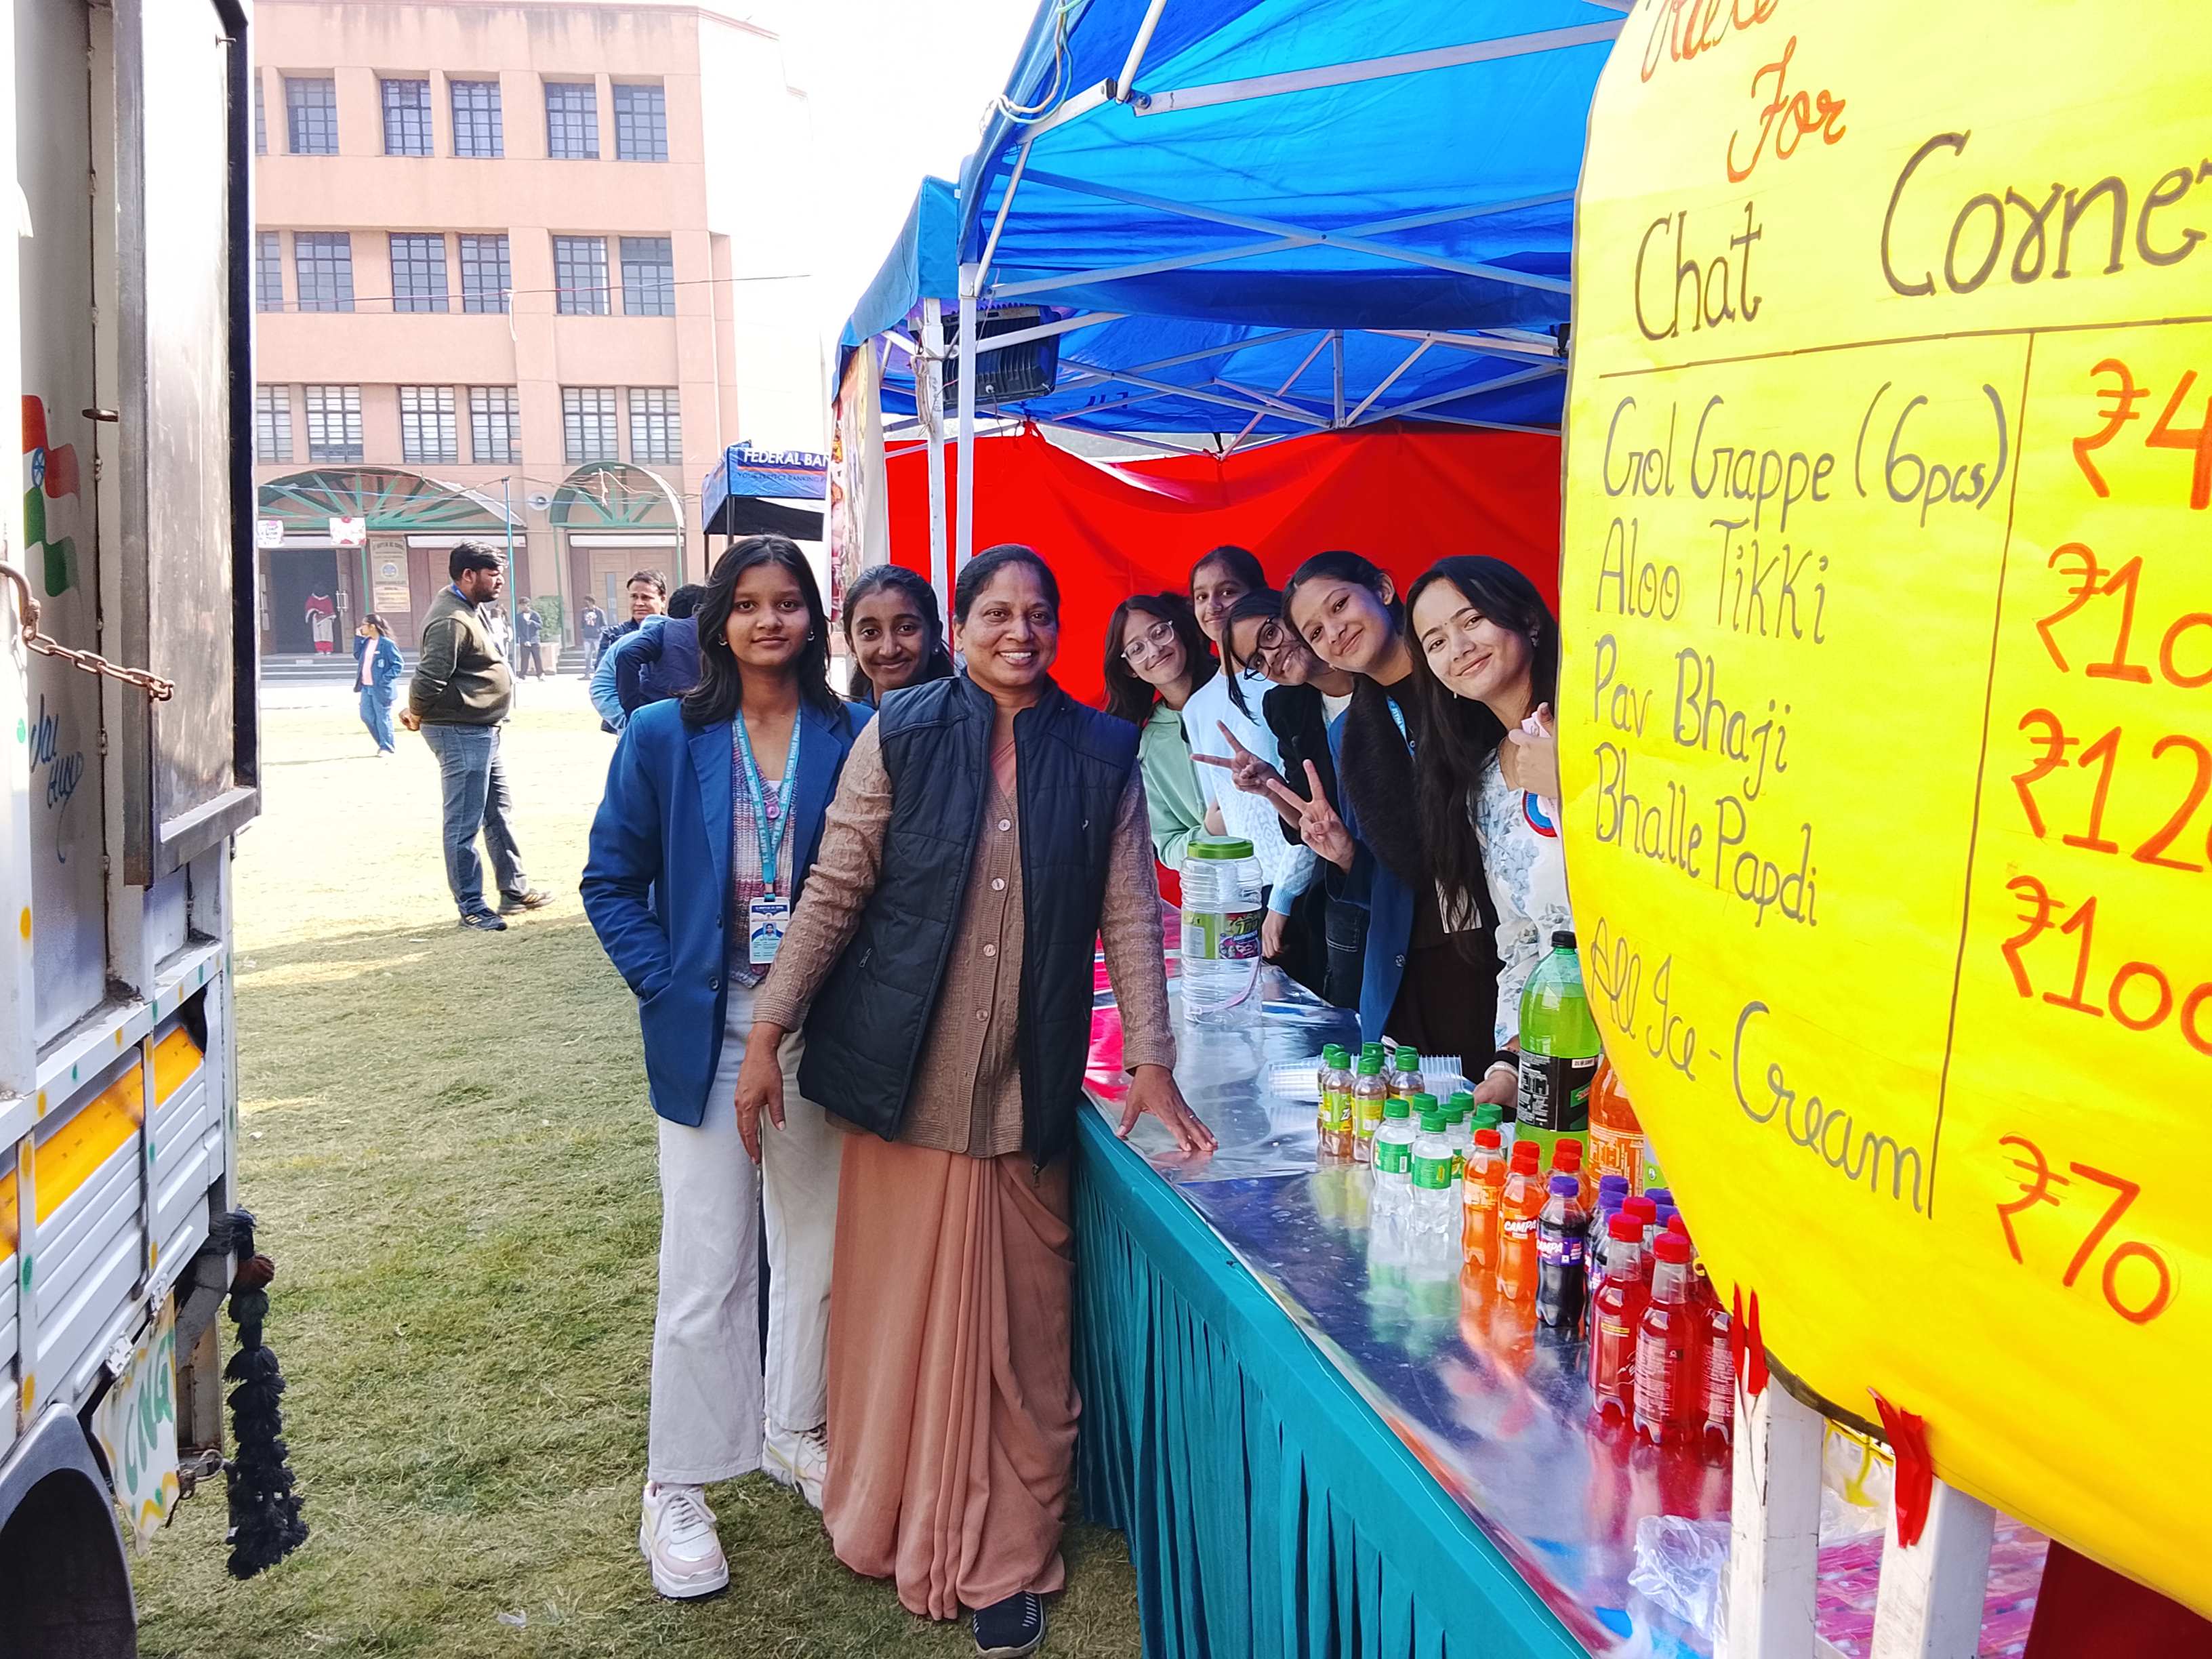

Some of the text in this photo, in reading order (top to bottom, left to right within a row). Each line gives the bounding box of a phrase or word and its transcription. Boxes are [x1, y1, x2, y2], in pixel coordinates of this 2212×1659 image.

[1727, 35, 1846, 183] For
[1635, 201, 1761, 341] Chat
[743, 449, 801, 466] FEDERAL
[1603, 396, 1676, 496] Gol
[1691, 394, 1835, 533] Gappe
[1596, 517, 1680, 621] Aloo
[1594, 634, 1791, 801] Pav Bhaji
[2011, 708, 2212, 873] ₹12
[1594, 742, 1817, 927] Bhalle Papdi
[1504, 1220, 1536, 1233] CAMPA
[1996, 1134, 2171, 1325] ₹70
[125, 1327, 174, 1496] CNG
